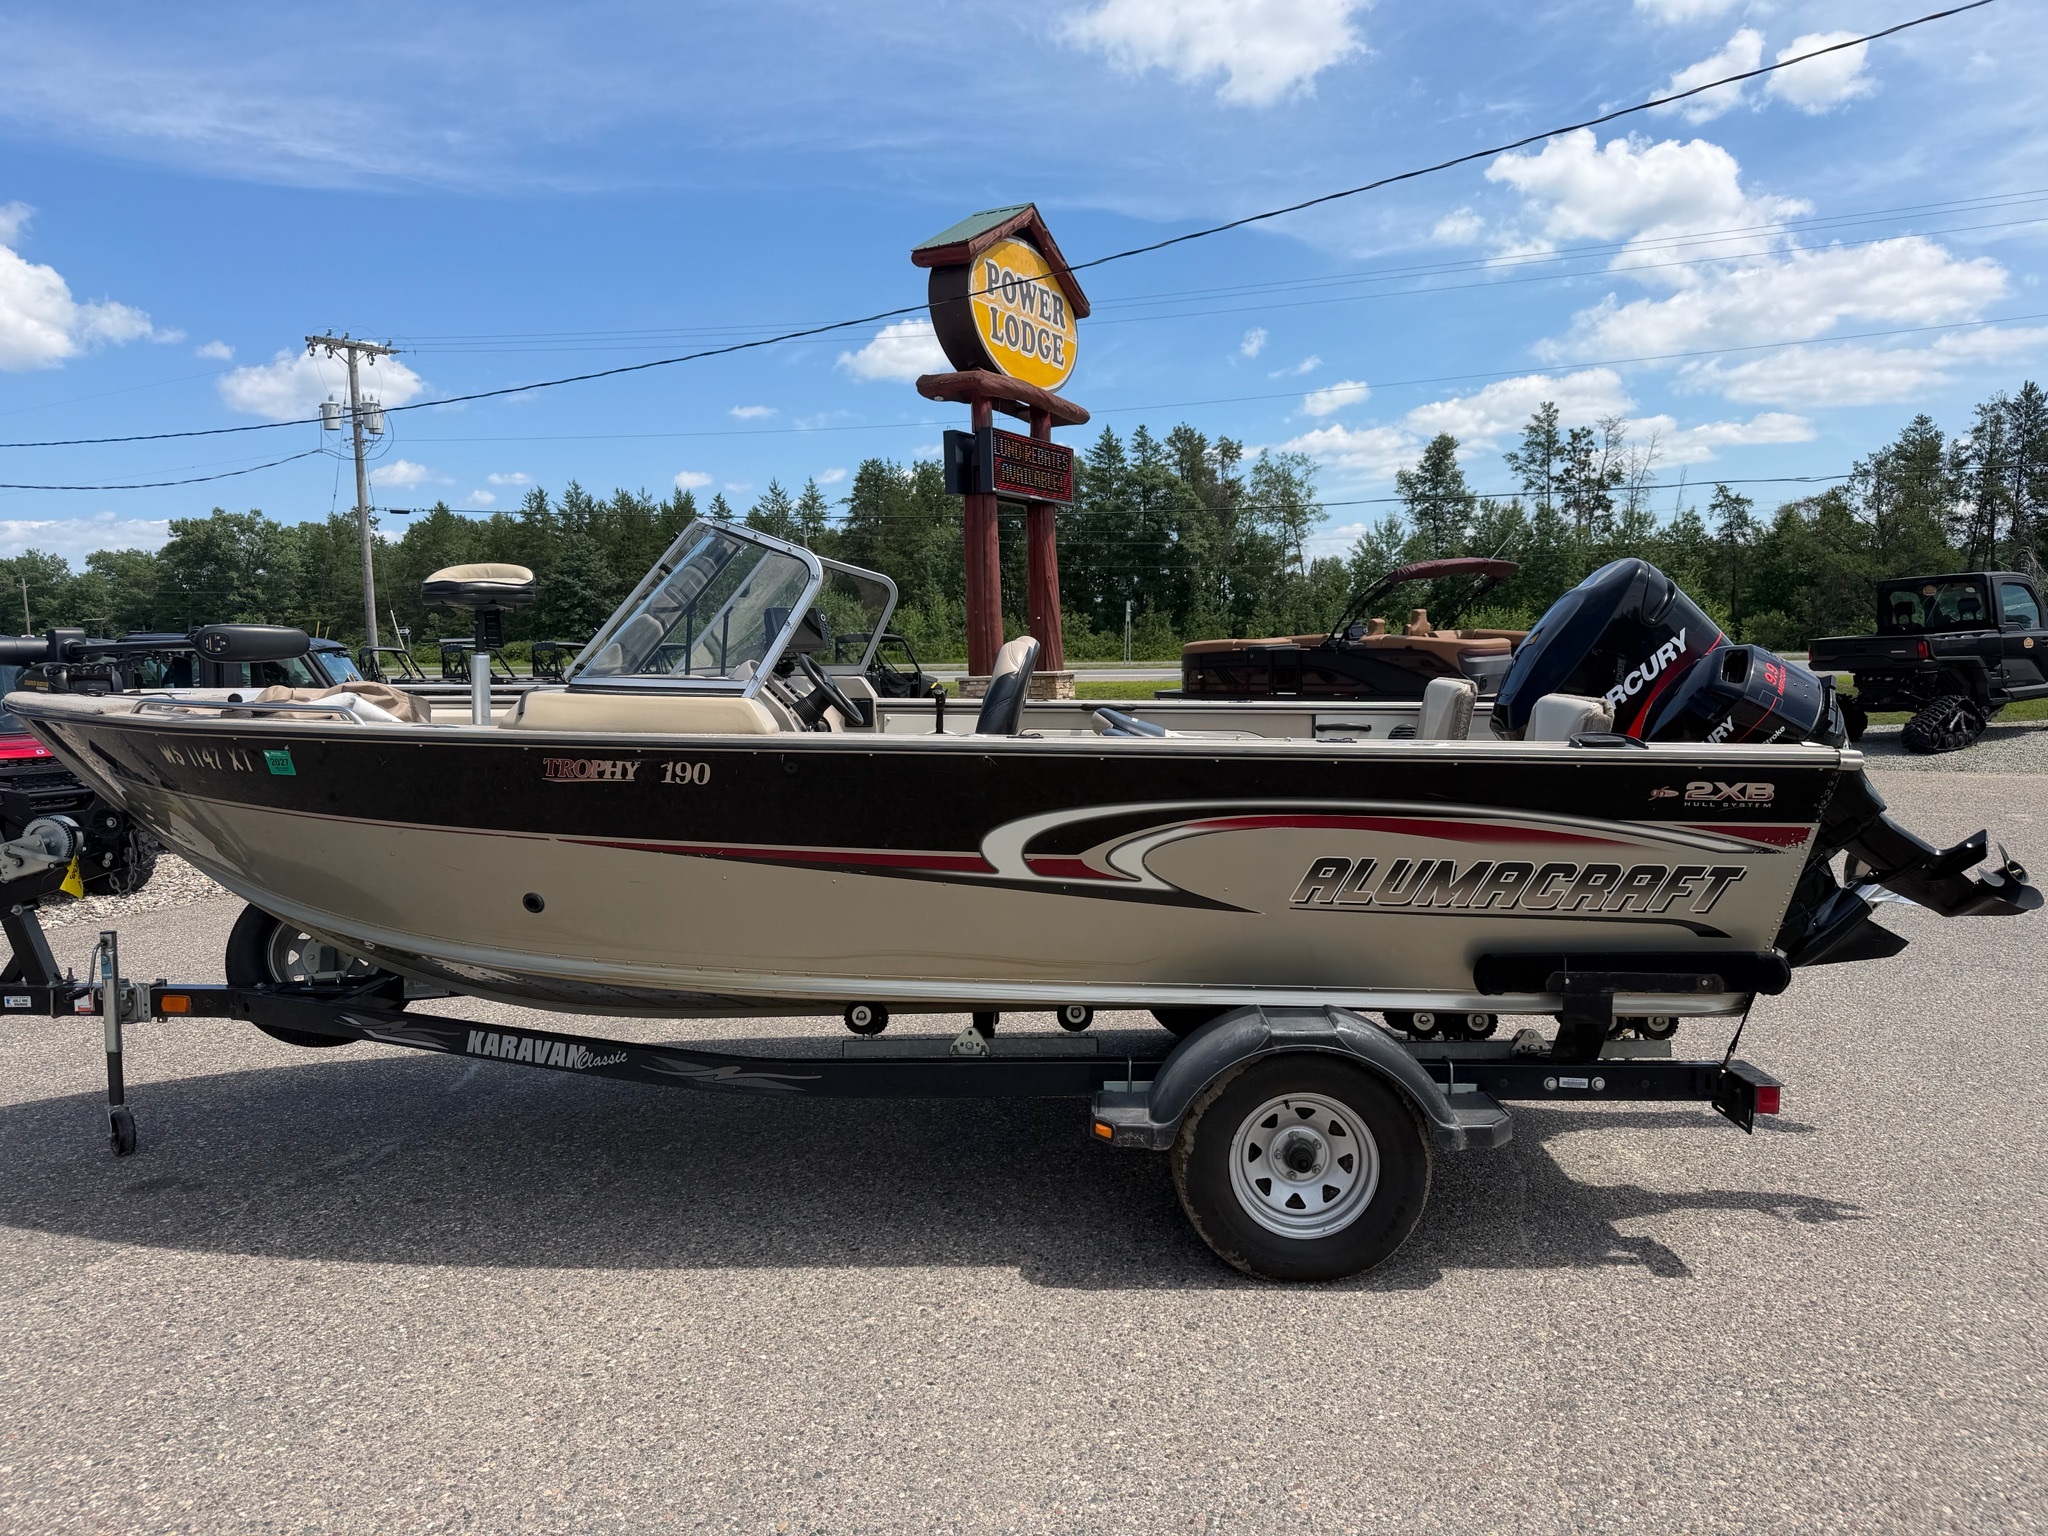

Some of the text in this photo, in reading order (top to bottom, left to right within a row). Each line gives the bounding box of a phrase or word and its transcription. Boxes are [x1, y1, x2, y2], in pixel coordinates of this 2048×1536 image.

[985, 260, 1066, 330] POWER
[989, 306, 1065, 367] LODGE
[1602, 627, 1687, 710] RCURY
[1777, 664, 1787, 696] MERCURY
[269, 757, 290, 767] 2027
[543, 757, 711, 785] TROPHY 190
[1684, 781, 1775, 802] 2XB
[1289, 856, 1748, 914] ALUMACRAFT
[466, 1030, 628, 1070] KARAVAN Classic
